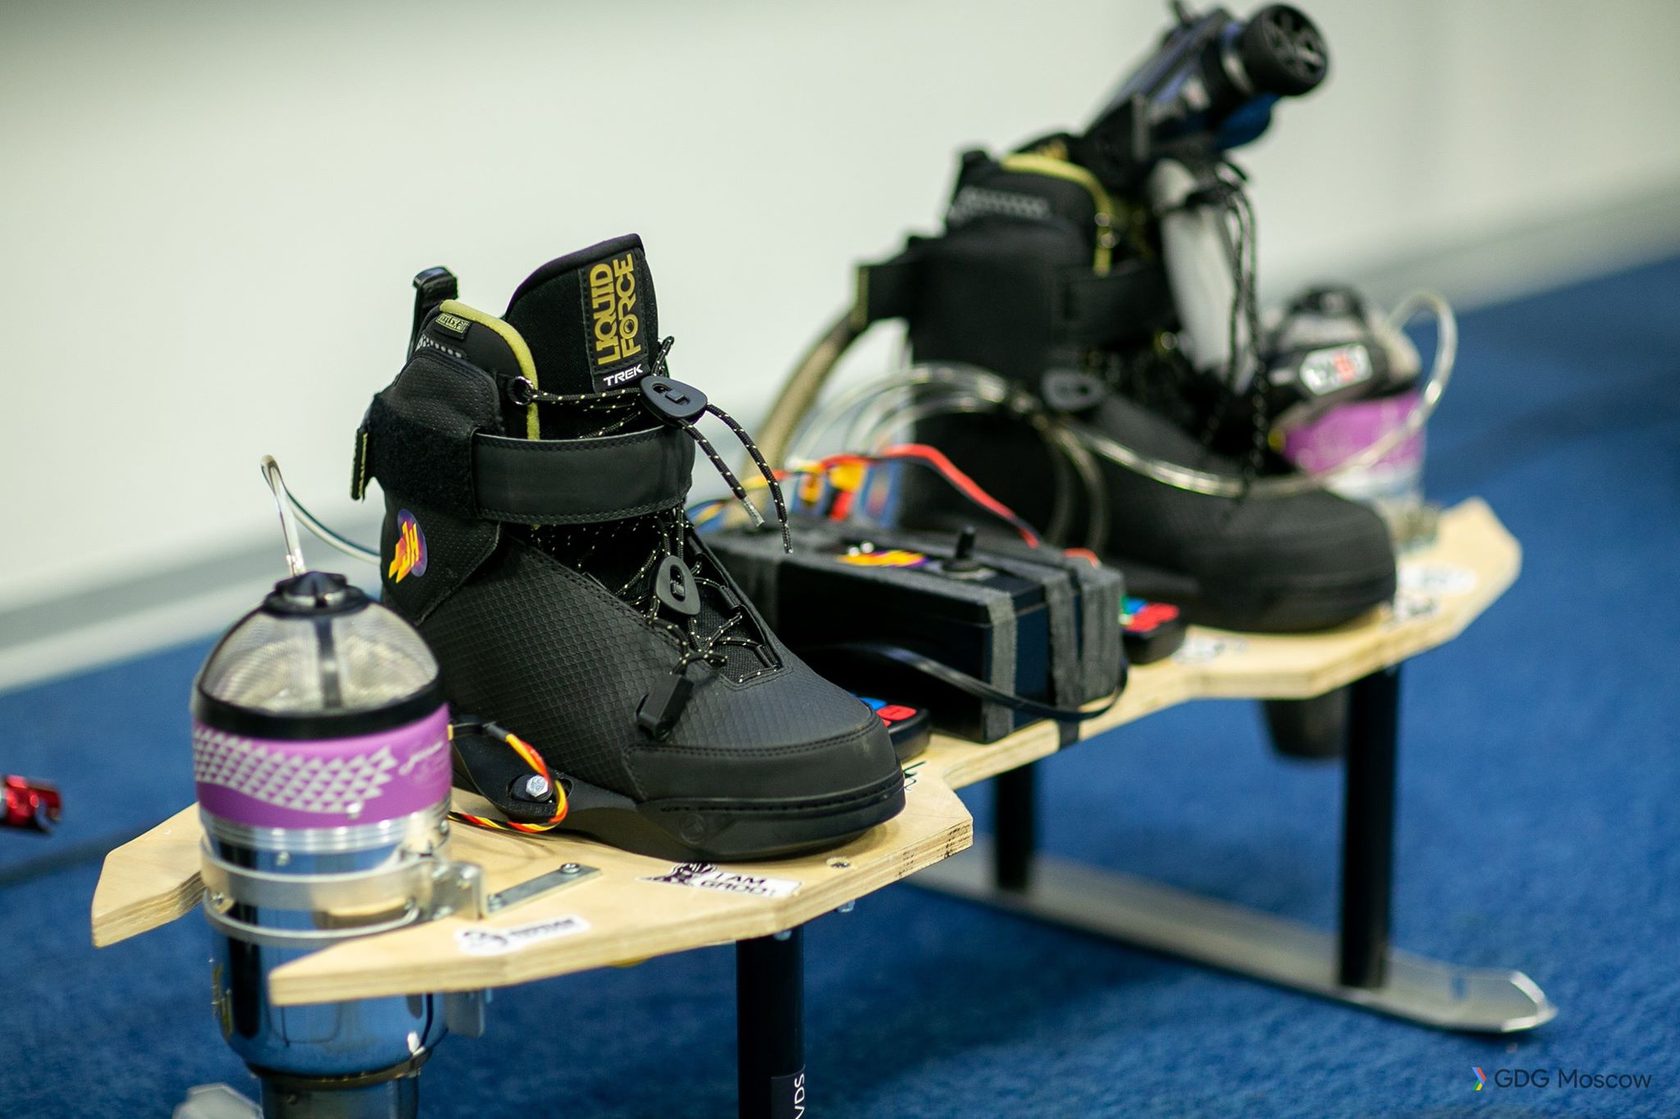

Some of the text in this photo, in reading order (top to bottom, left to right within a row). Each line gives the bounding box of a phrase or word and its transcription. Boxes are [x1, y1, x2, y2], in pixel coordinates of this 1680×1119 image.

[590, 263, 621, 365] LIQUID
[613, 253, 641, 358] FORCE
[603, 364, 643, 386] TREK
[728, 875, 766, 885] AM
